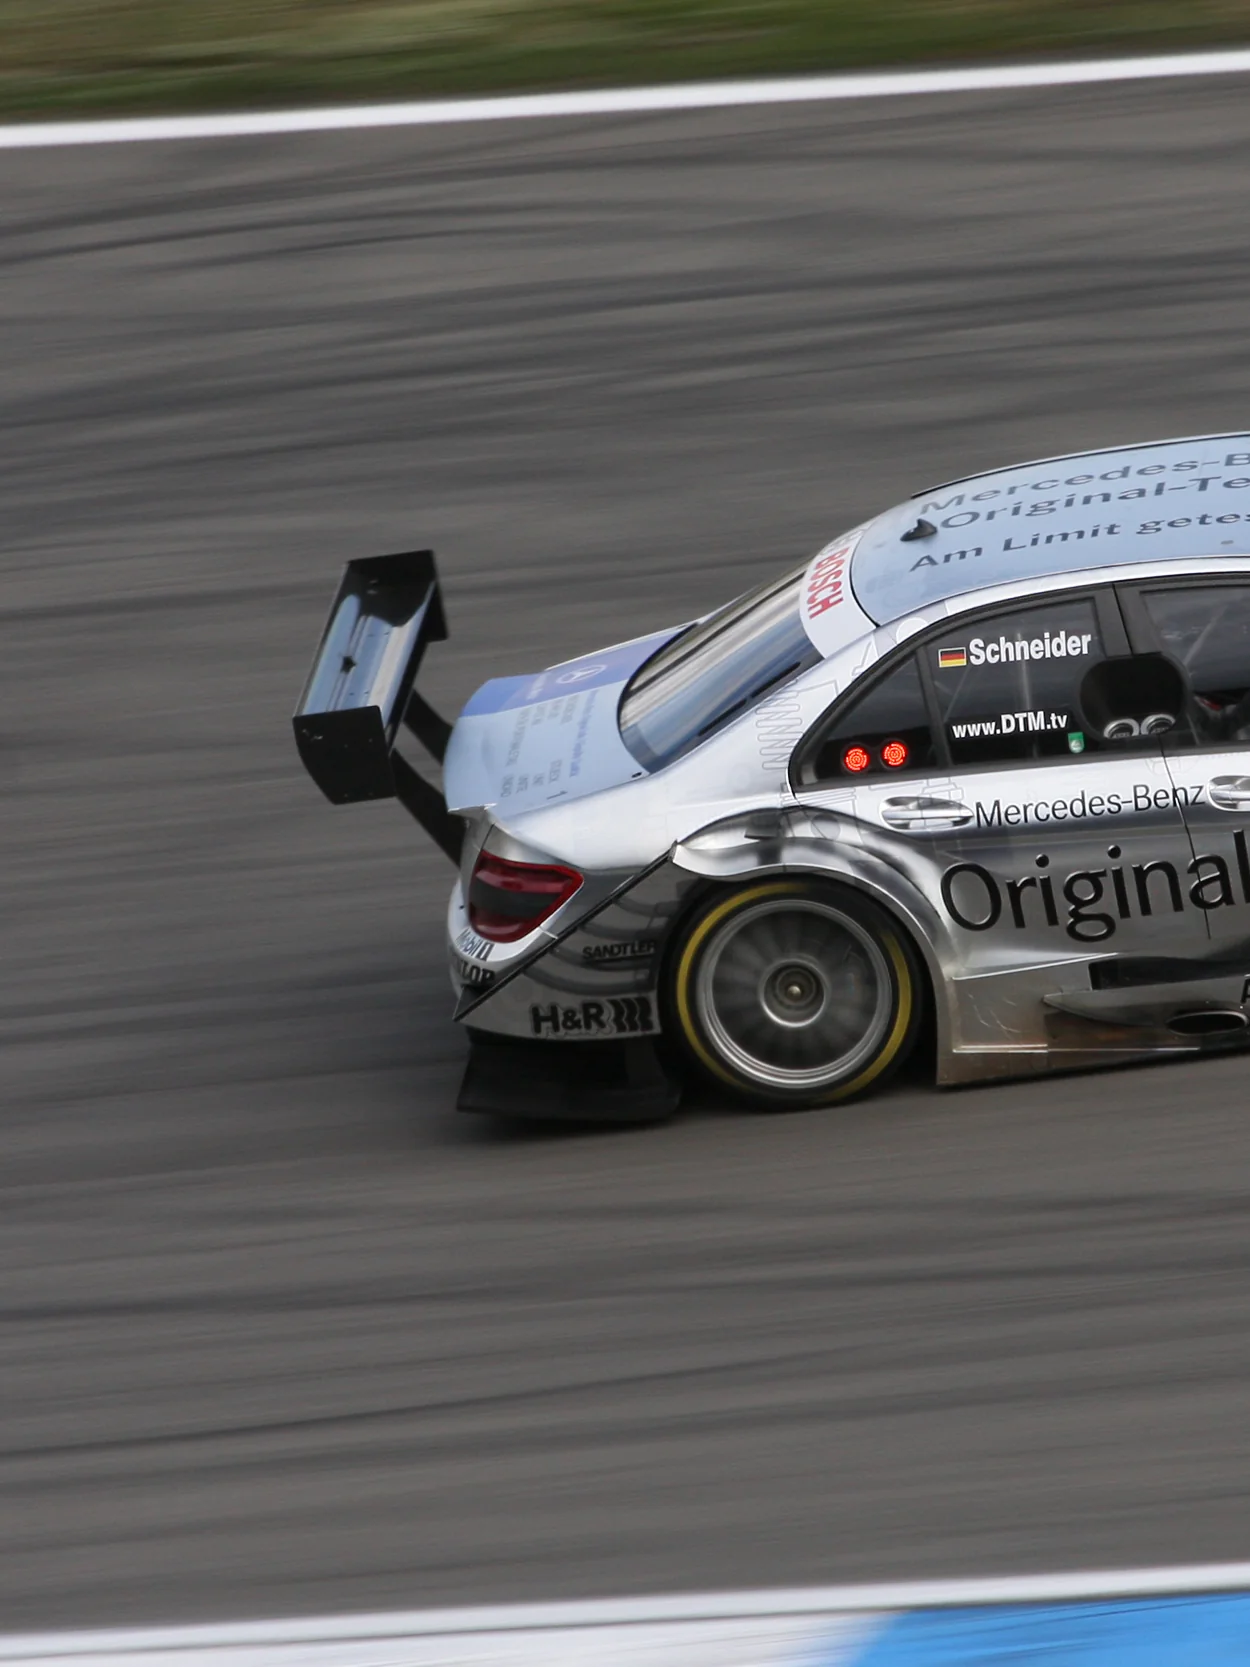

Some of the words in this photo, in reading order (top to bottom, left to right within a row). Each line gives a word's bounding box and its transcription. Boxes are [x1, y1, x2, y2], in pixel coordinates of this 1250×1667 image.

[909, 547, 983, 572] Am
[1003, 524, 1121, 552] Limit
[807, 547, 850, 619] BOSCH
[969, 631, 1092, 666] Schneider
[952, 711, 1067, 738] www.DTM.tv
[975, 784, 1205, 828] Mercedes-Benz
[531, 1002, 607, 1033] H&R
